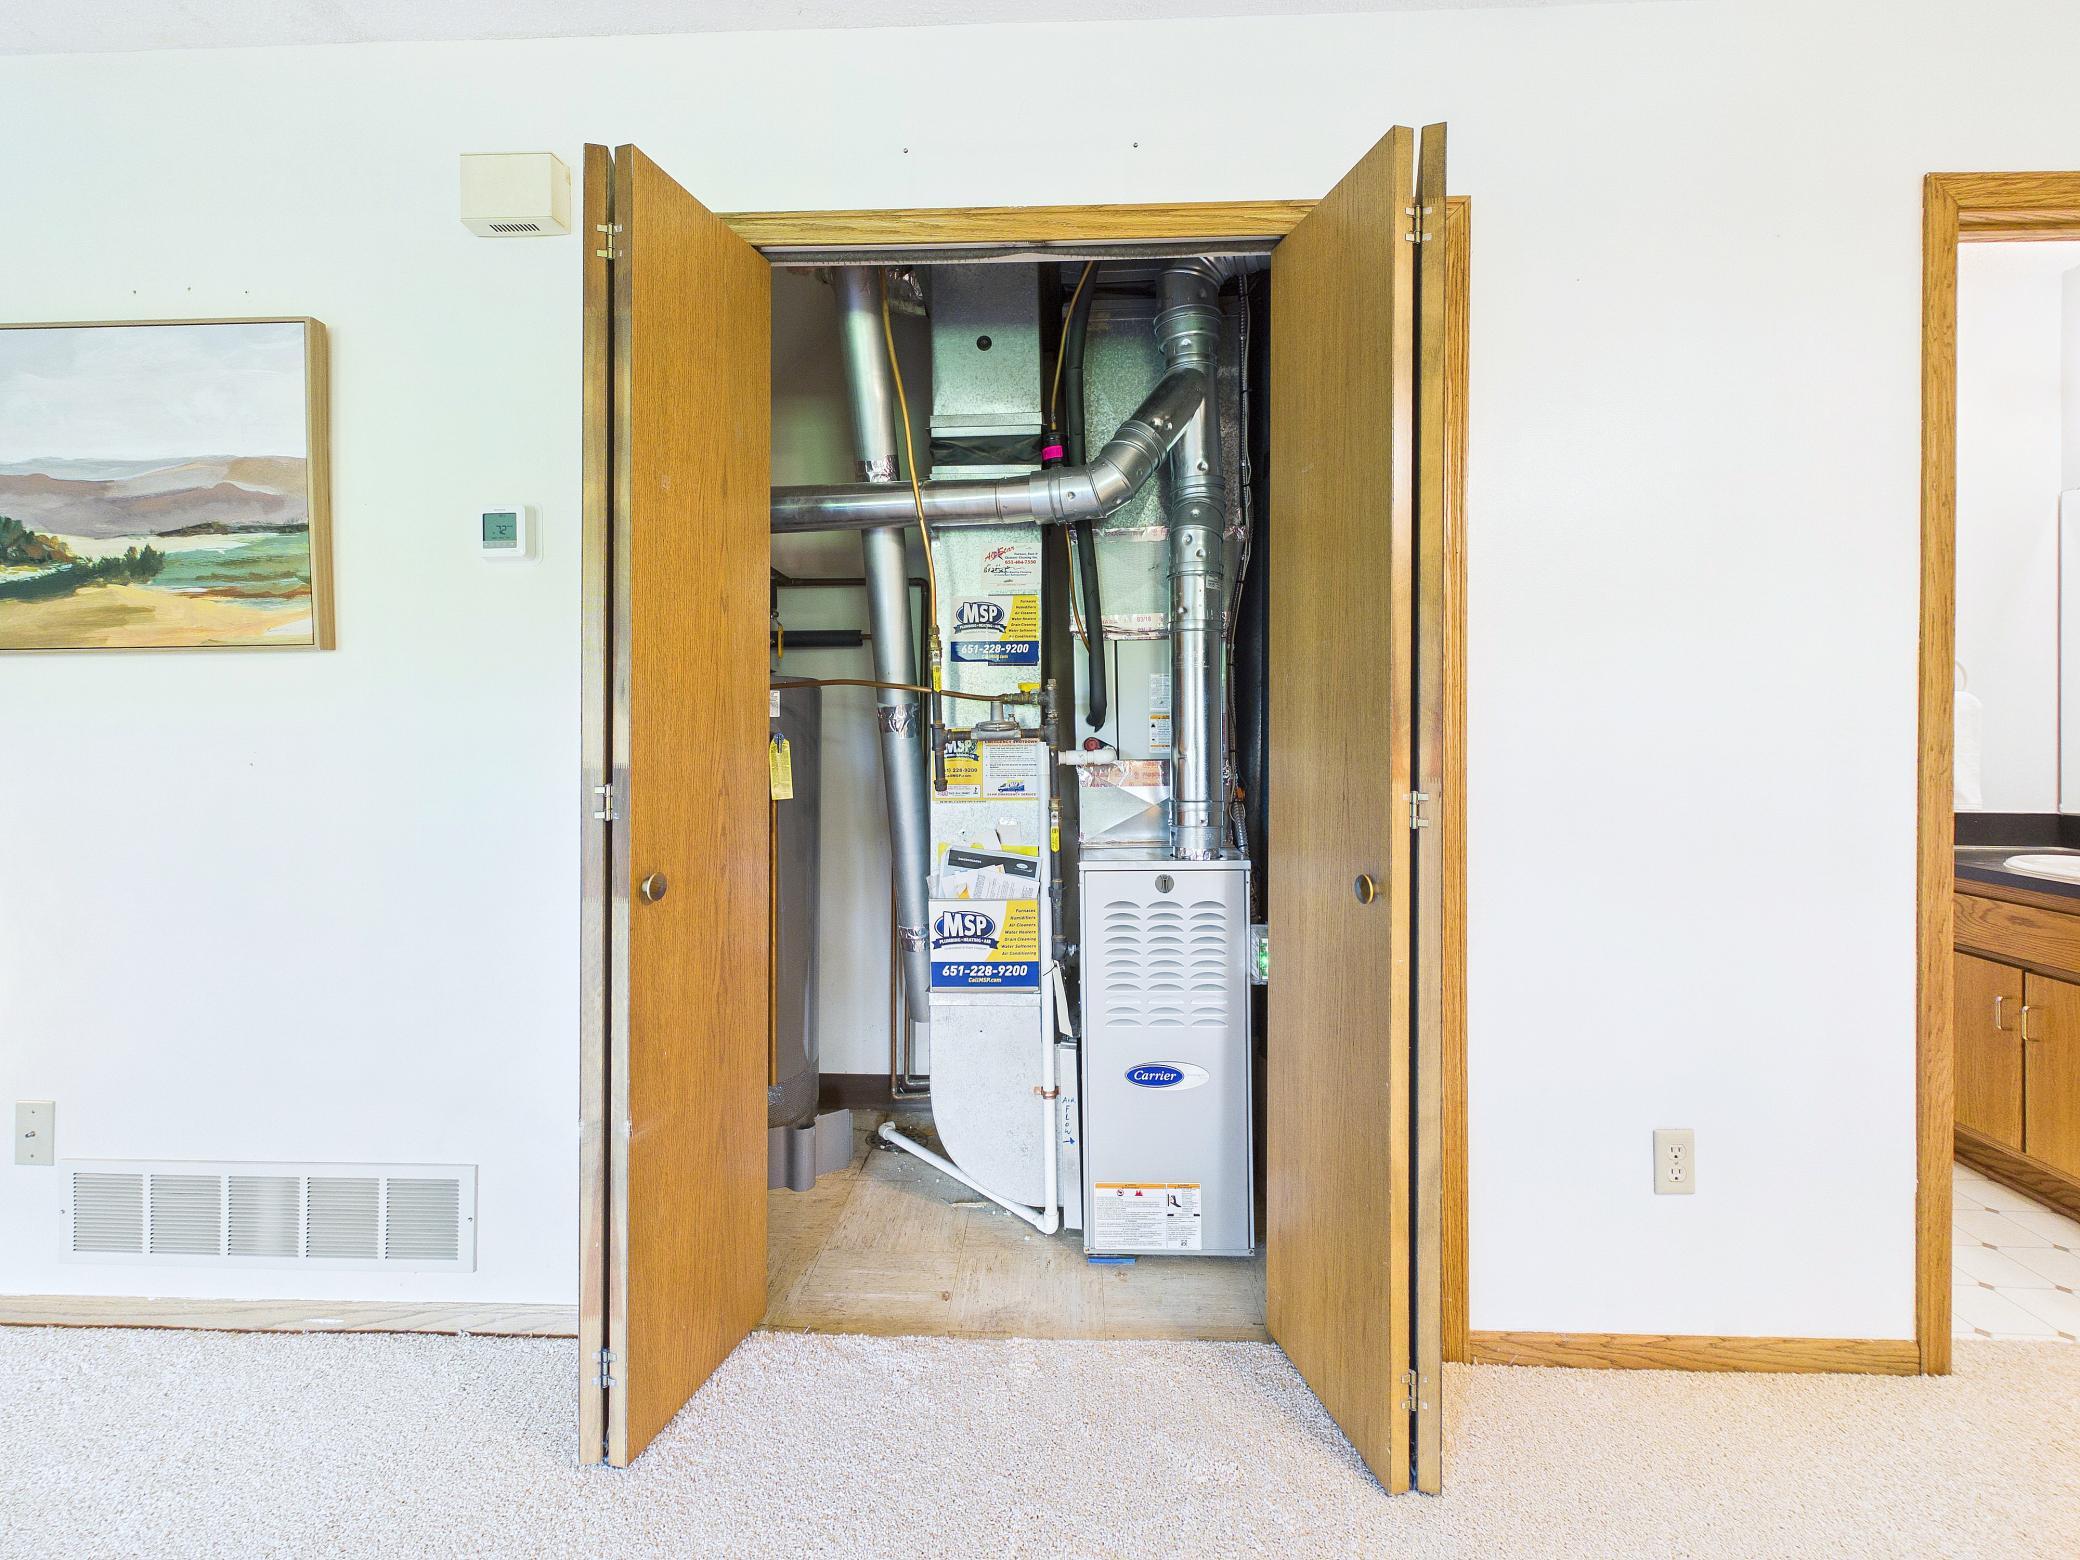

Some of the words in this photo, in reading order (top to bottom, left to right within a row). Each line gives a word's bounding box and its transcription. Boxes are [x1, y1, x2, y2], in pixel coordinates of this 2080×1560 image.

[963, 602, 997, 623] MSP
[961, 644, 1029, 654] 651-228-9200
[943, 911, 987, 937] MSP
[942, 964, 1028, 976] 651-228-9200
[1133, 1070, 1177, 1081] Carrier
